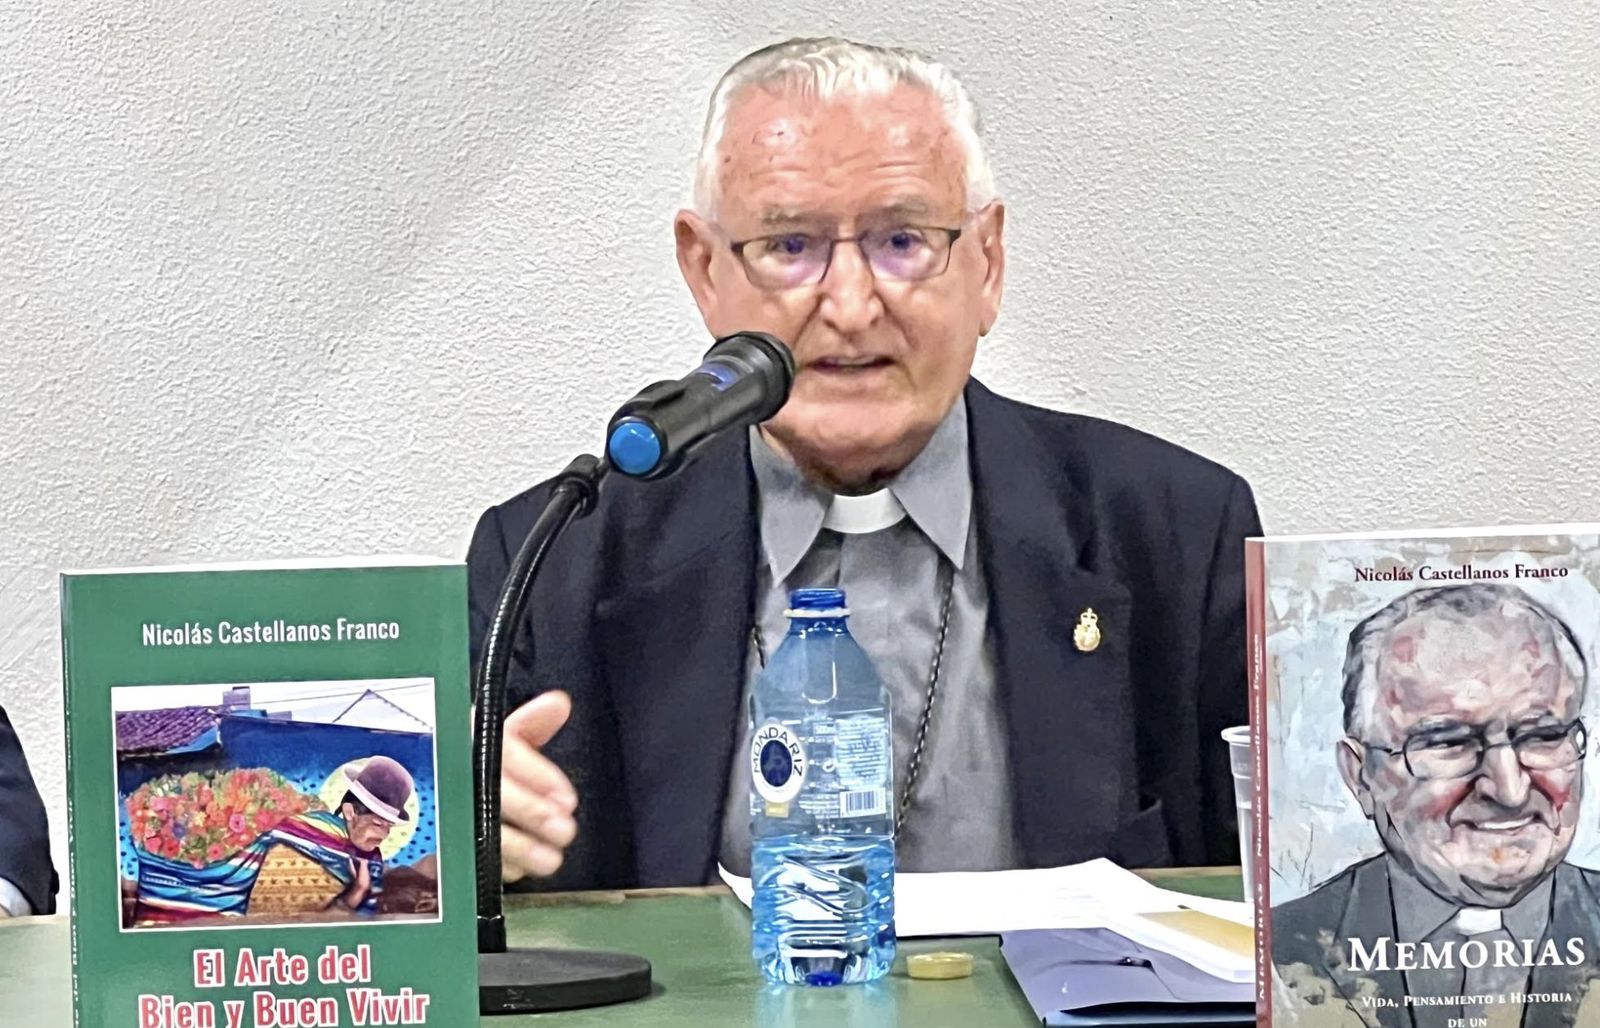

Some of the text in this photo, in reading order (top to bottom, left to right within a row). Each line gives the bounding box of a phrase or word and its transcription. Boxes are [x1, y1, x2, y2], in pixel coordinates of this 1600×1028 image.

[1354, 563, 1569, 582] Nicolás Castellanos Franco
[142, 617, 400, 646] Nicolás Castellanos Franco
[753, 727, 803, 777] MONDARIZ
[193, 944, 371, 988] El Arte del
[1347, 937, 1586, 972] MEMORIAS
[138, 987, 430, 1028] Bien y Buen Vivir
[1362, 996, 1400, 1008] VIDA,
[1403, 994, 1494, 1007] PENSAMIENTO
[1510, 991, 1573, 1004] HISTORIA
[1447, 1017, 1487, 1028] DE UN
